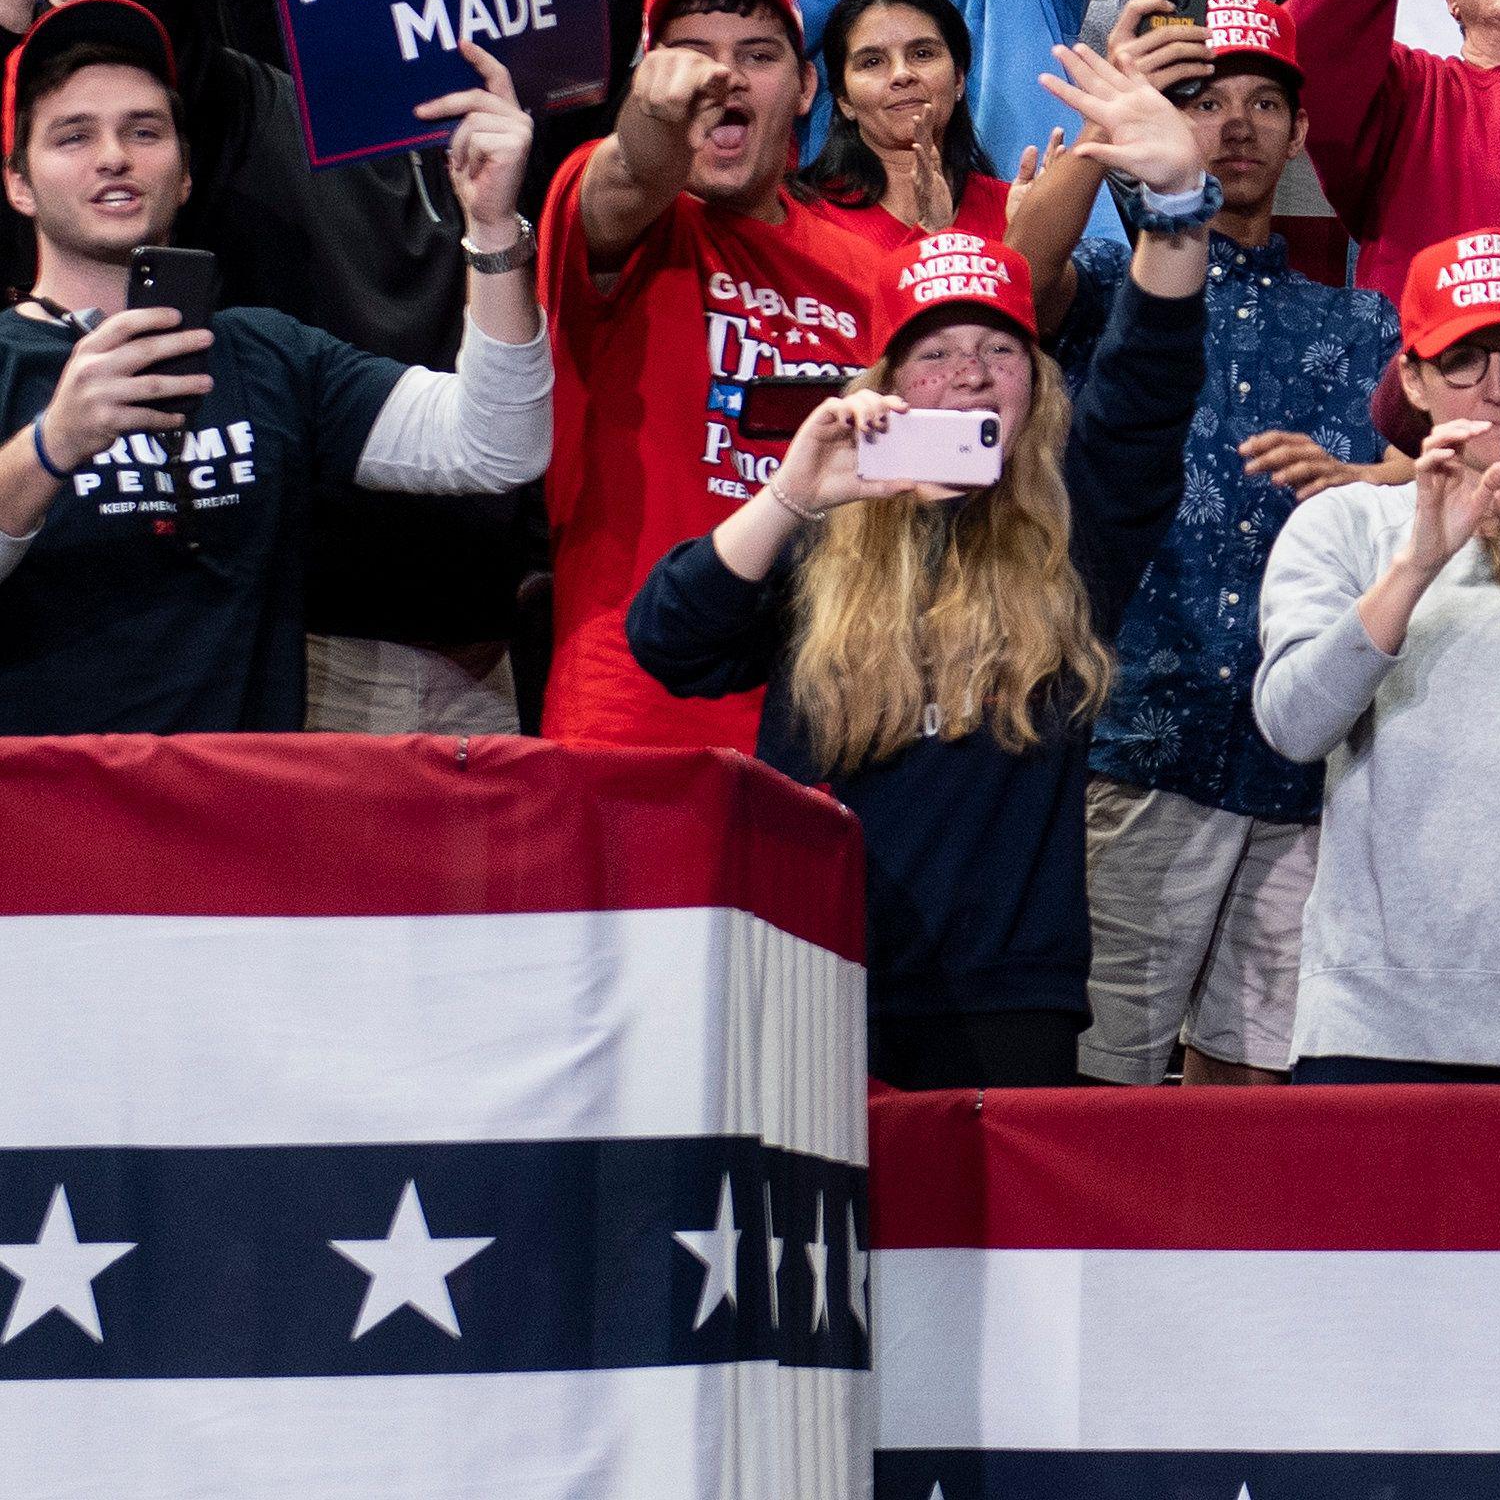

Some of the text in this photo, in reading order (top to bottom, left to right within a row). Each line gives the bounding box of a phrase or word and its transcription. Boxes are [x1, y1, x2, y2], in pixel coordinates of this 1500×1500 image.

[919, 235, 986, 258] KEEP
[898, 252, 1012, 290] AMERICA
[912, 275, 999, 302] GREAT
